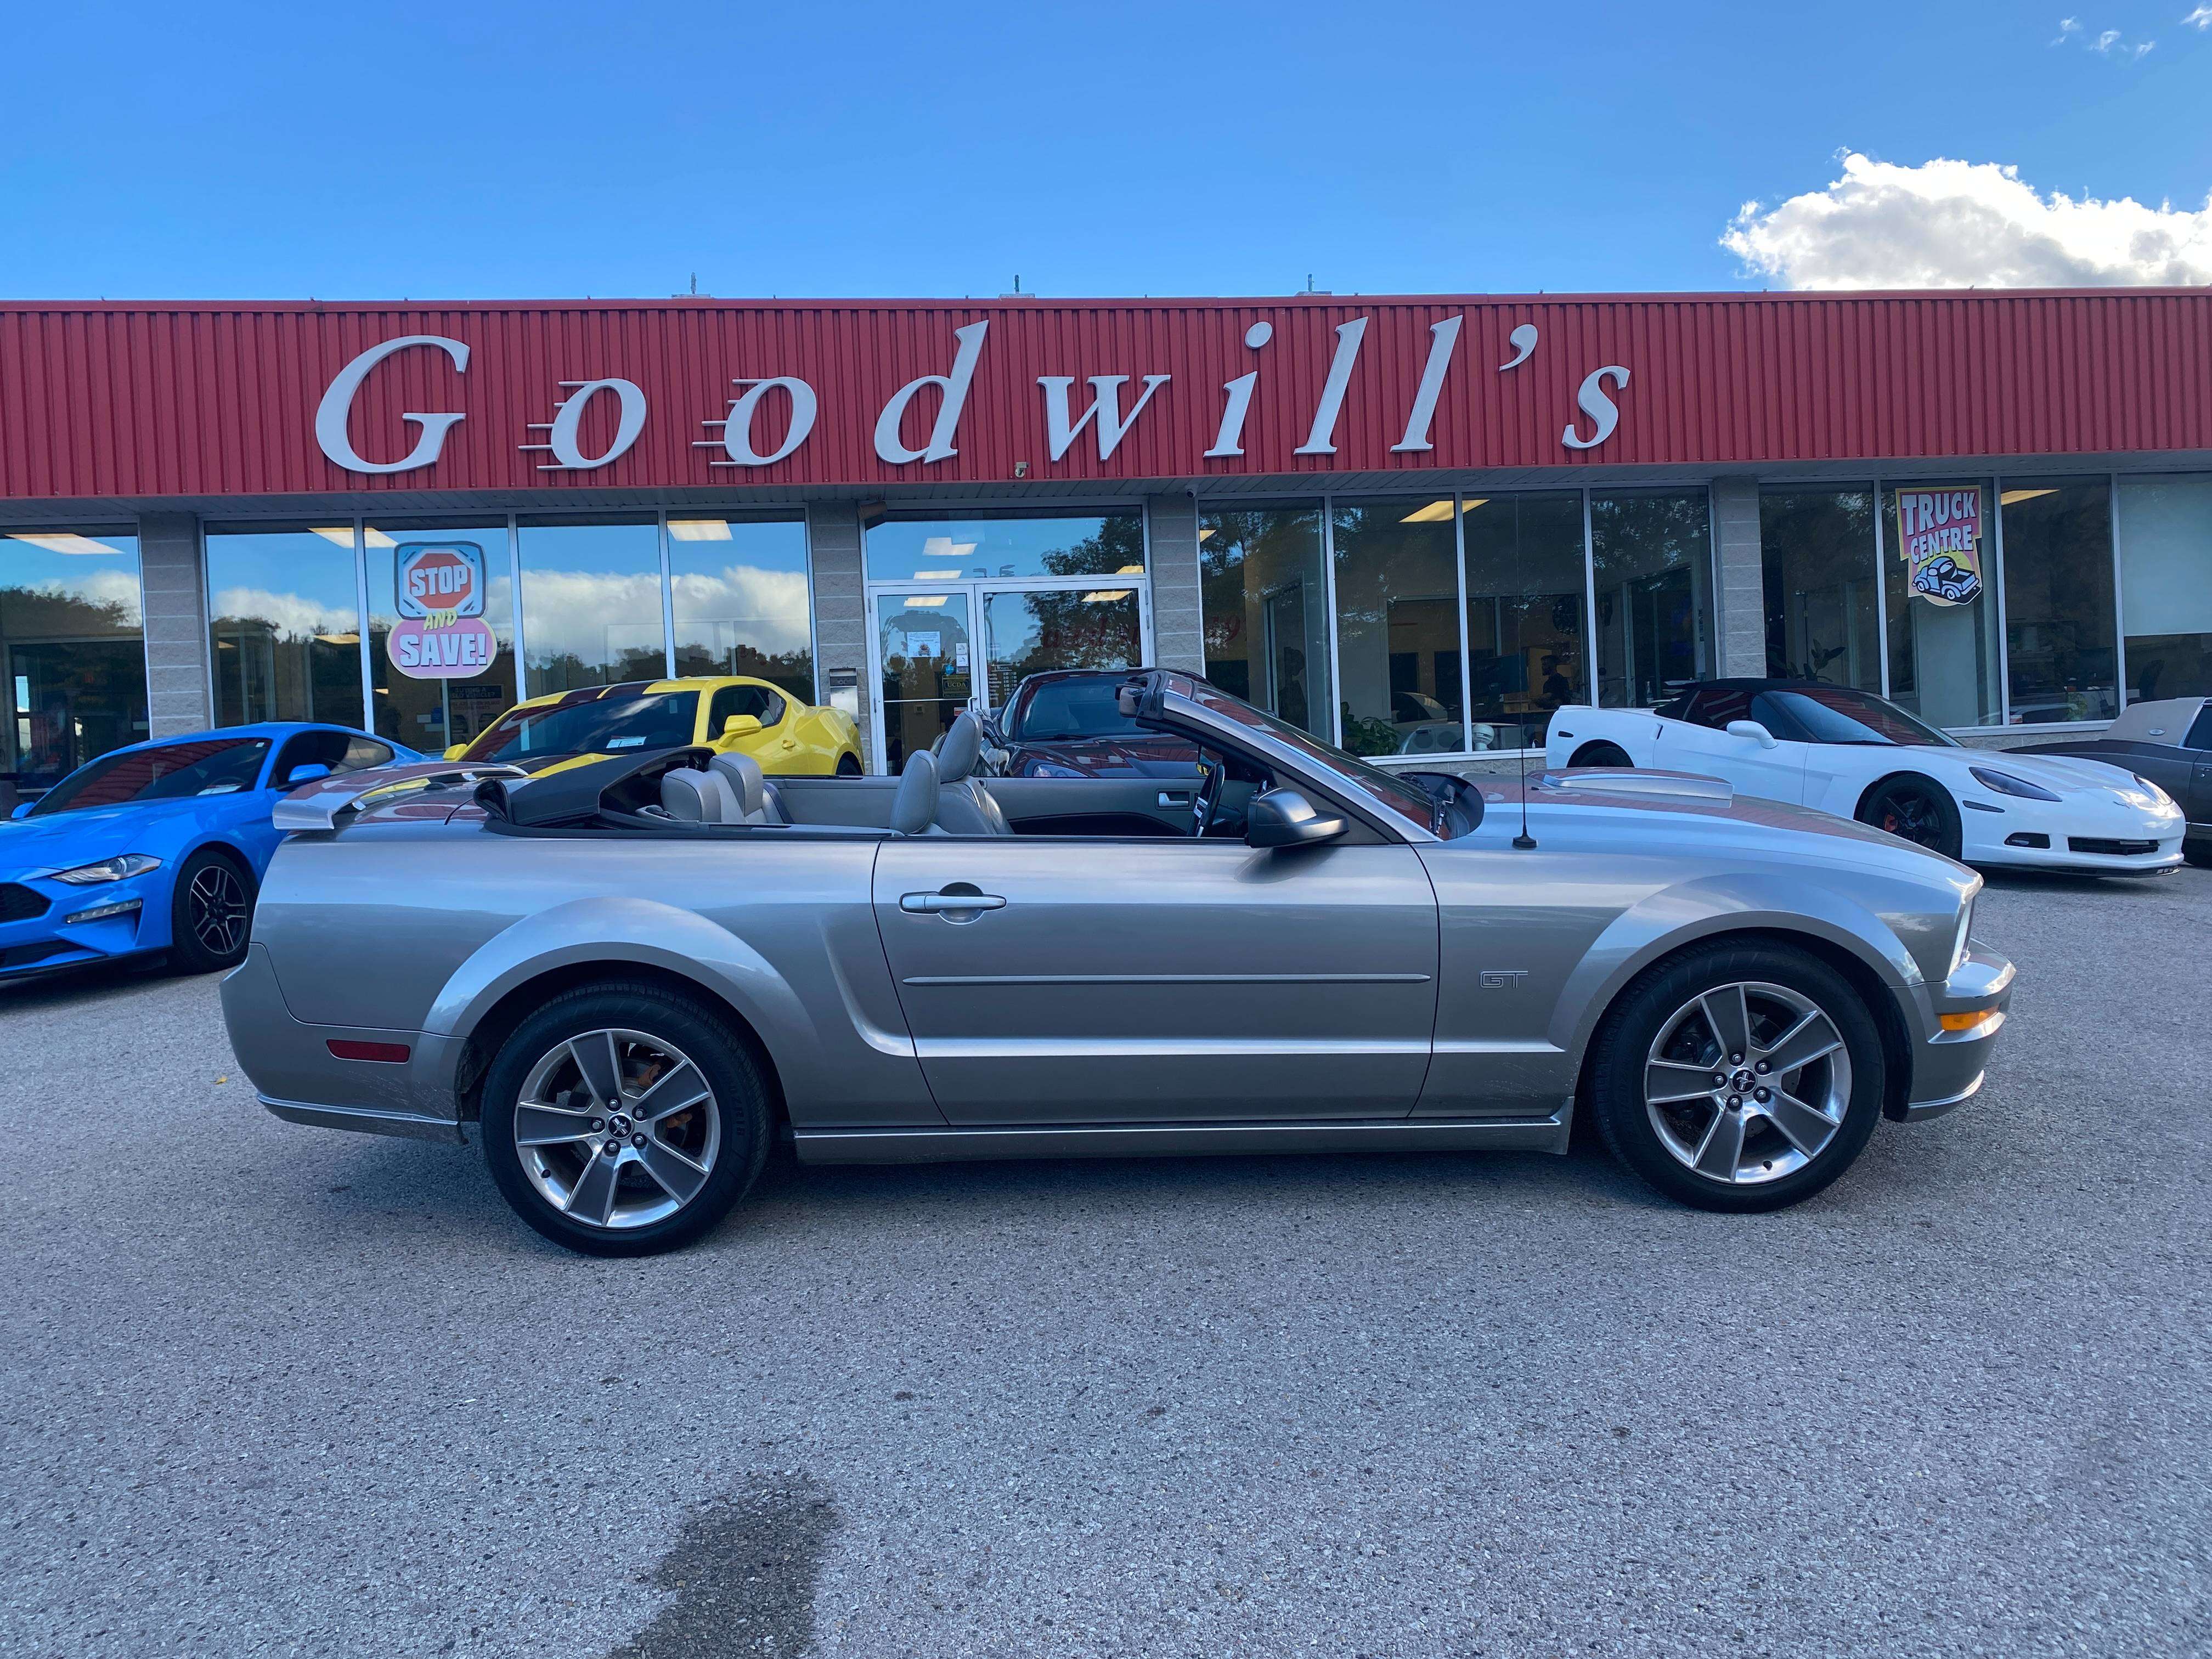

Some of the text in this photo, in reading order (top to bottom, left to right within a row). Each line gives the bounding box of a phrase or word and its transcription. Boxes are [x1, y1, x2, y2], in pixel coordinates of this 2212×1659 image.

[315, 314, 1630, 475] Goodwill's
[1901, 492, 1977, 537] TRUCK
[1910, 524, 1974, 564] CENTRE
[411, 565, 468, 597] STOP
[423, 610, 458, 631] AND
[399, 633, 487, 667] SAVE!
[1480, 970, 1528, 988] GT
